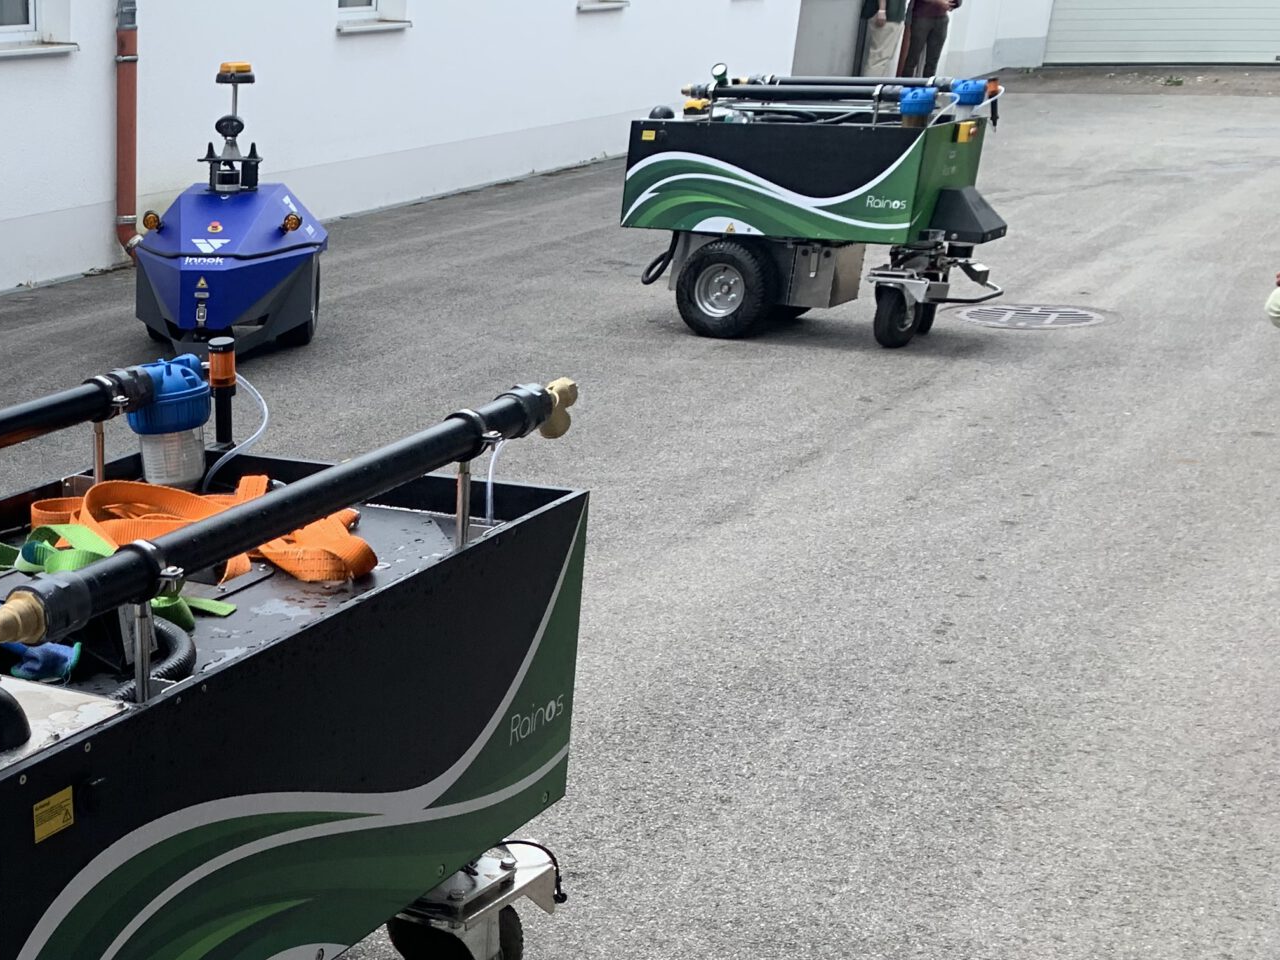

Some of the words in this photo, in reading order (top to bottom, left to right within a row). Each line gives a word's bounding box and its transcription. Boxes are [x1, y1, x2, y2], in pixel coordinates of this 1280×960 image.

[866, 195, 907, 209] Rainos
[185, 256, 225, 264] Innok
[509, 693, 564, 746] Rainos
